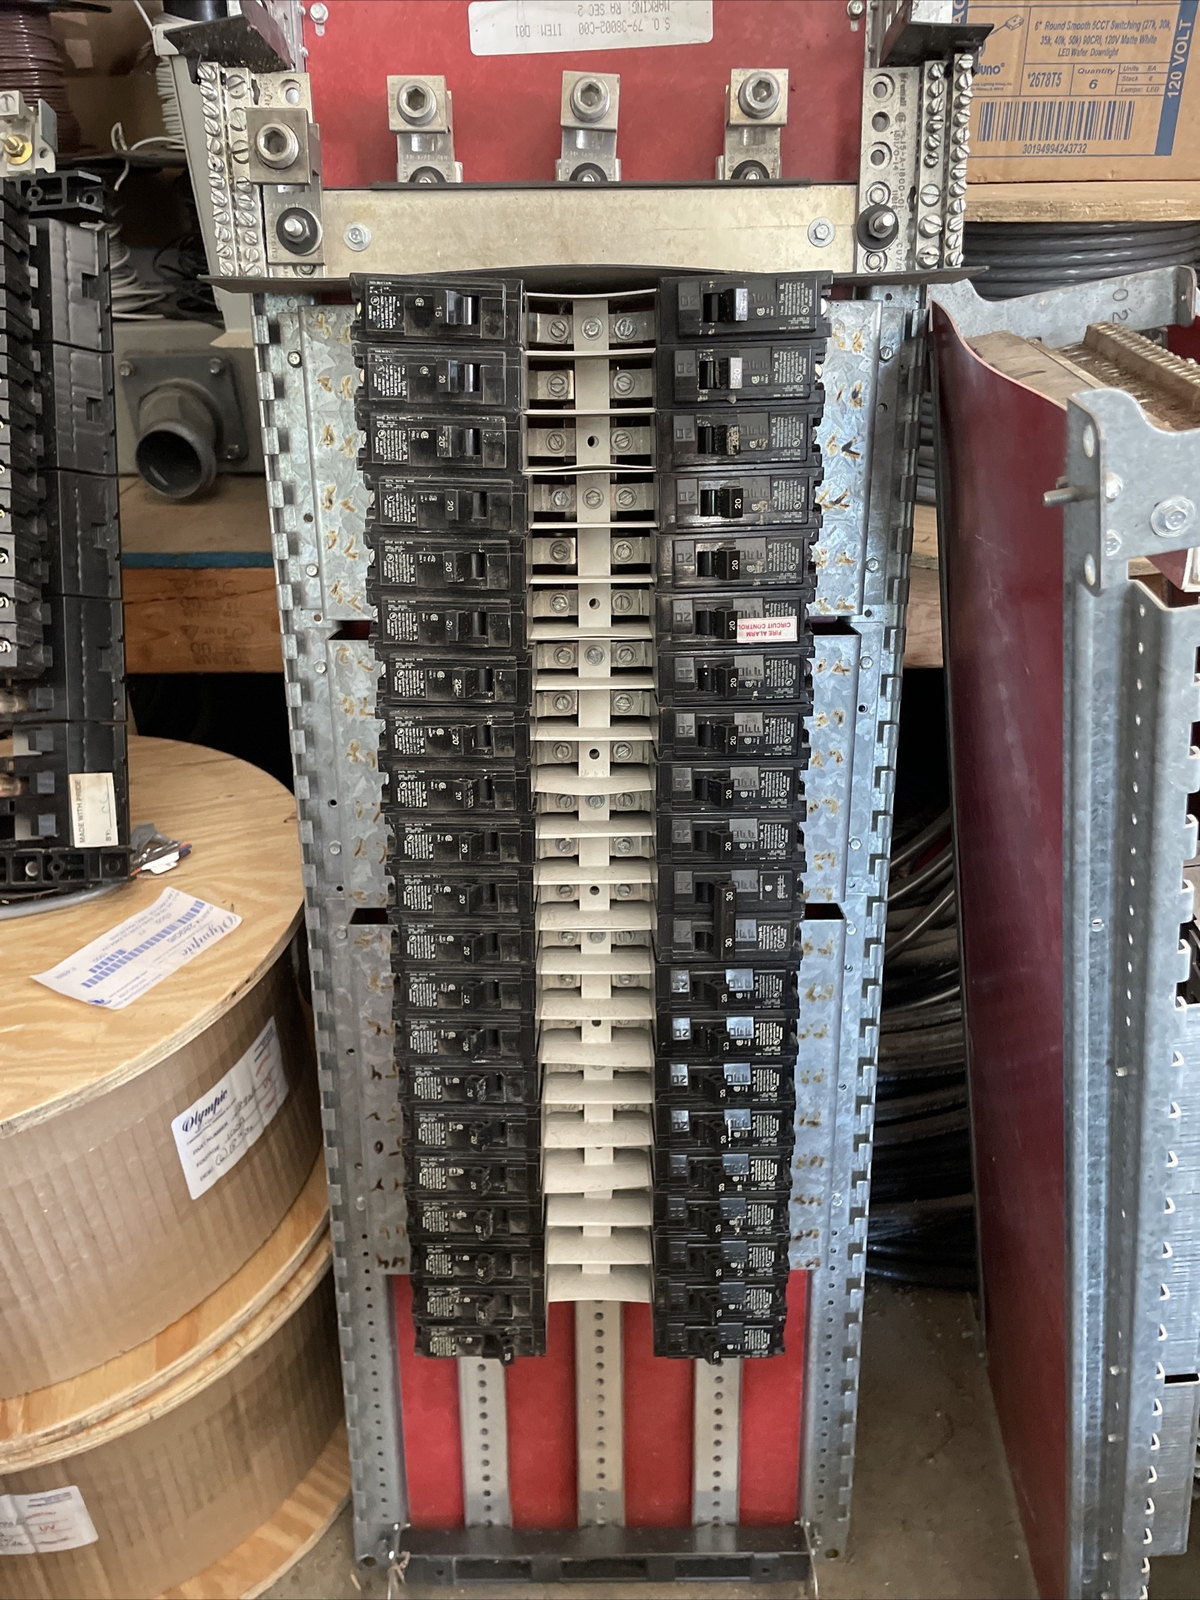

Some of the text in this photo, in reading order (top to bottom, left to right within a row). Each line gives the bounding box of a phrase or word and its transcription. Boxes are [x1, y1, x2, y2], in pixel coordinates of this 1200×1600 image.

[577, 4, 584, 17] 2
[588, 4, 606, 16] SEC
[537, 24, 562, 37] ITEM:
[1044, 20, 1065, 30] Round
[1066, 20, 1091, 30] Smooth
[1110, 20, 1141, 32] Switching
[1105, 35, 1120, 44] 120V
[1121, 35, 1138, 44] Matte
[1139, 34, 1157, 44] White
[1058, 48, 1119, 58] LED Wafer Downlight
[1167, 19, 1192, 98] 120 VOLT
[1089, 79, 1098, 90] 6
[435, 306, 442, 318] 15
[734, 368, 740, 379] 20
[438, 375, 446, 384] 20
[438, 435, 446, 448] 20
[447, 500, 454, 512] 20
[735, 498, 742, 509] 20
[446, 562, 452, 572] 20
[732, 560, 738, 570] 20
[729, 620, 736, 631] 20
[730, 677, 737, 688] 20
[452, 734, 459, 745] 20
[730, 736, 737, 745] 20
[456, 791, 462, 800] 20
[726, 789, 732, 799] 20
[462, 844, 468, 853] 20
[725, 842, 731, 851] 20
[459, 894, 466, 904] 20
[726, 892, 734, 901] 30
[736, 930, 755, 938] FF
[725, 937, 733, 947] 30
[464, 946, 470, 955] 20
[721, 993, 728, 1002] 20
[182, 1089, 228, 1132] Olympic
[471, 1181, 477, 1190] 20
[718, 1183, 725, 1192] 20
